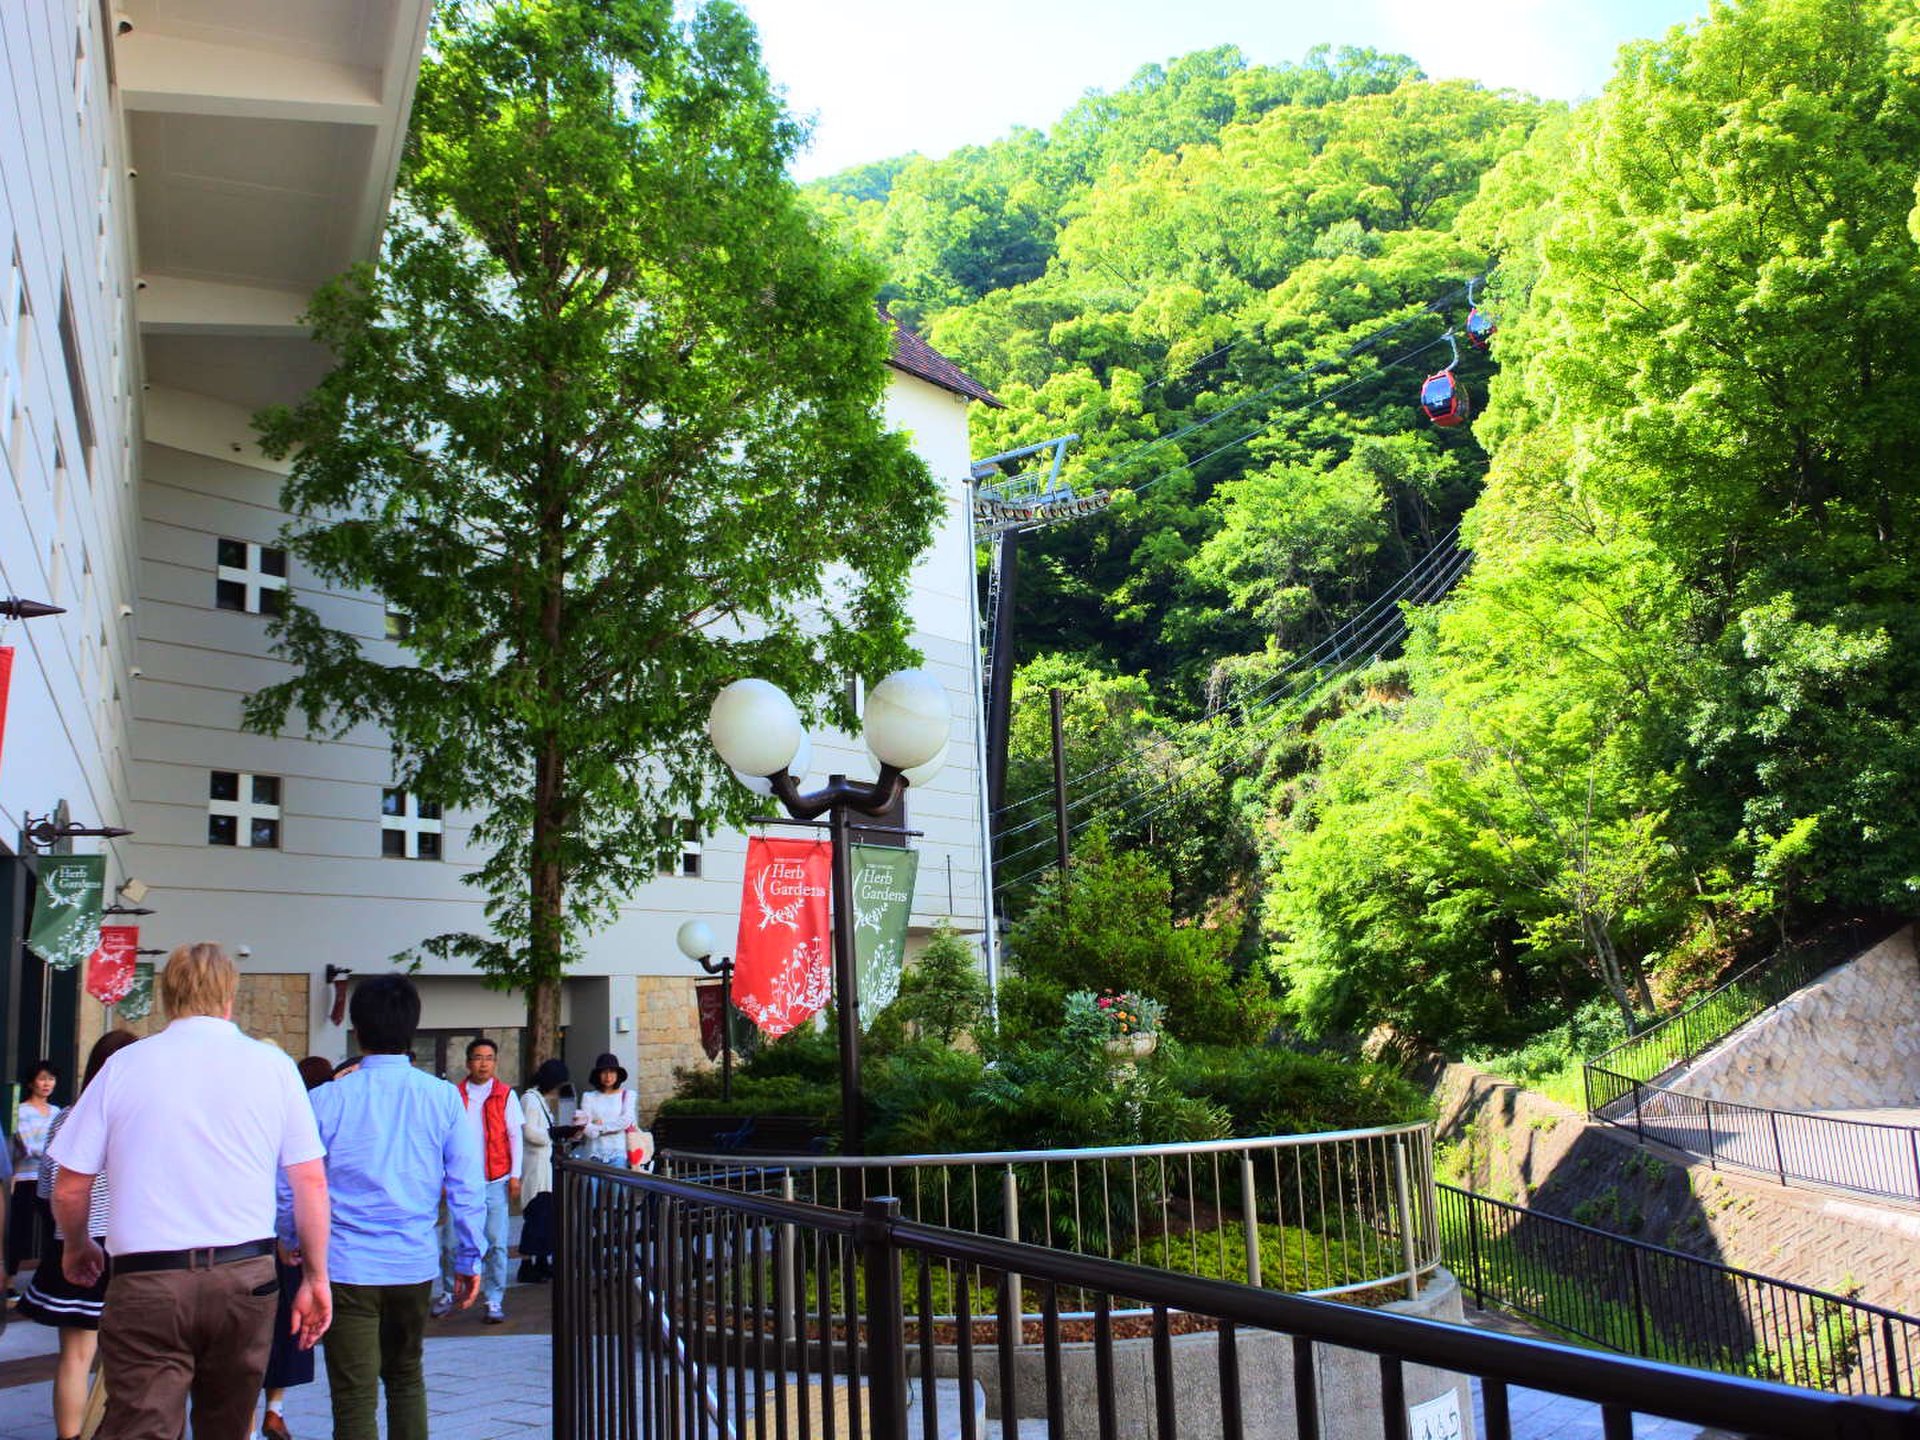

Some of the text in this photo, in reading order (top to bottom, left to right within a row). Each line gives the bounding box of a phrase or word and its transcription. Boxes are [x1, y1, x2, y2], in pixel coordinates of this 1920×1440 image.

[771, 864, 805, 879] Herb
[864, 869, 893, 885] Herb
[770, 880, 826, 897] Gardens
[862, 885, 908, 902] Gardens
